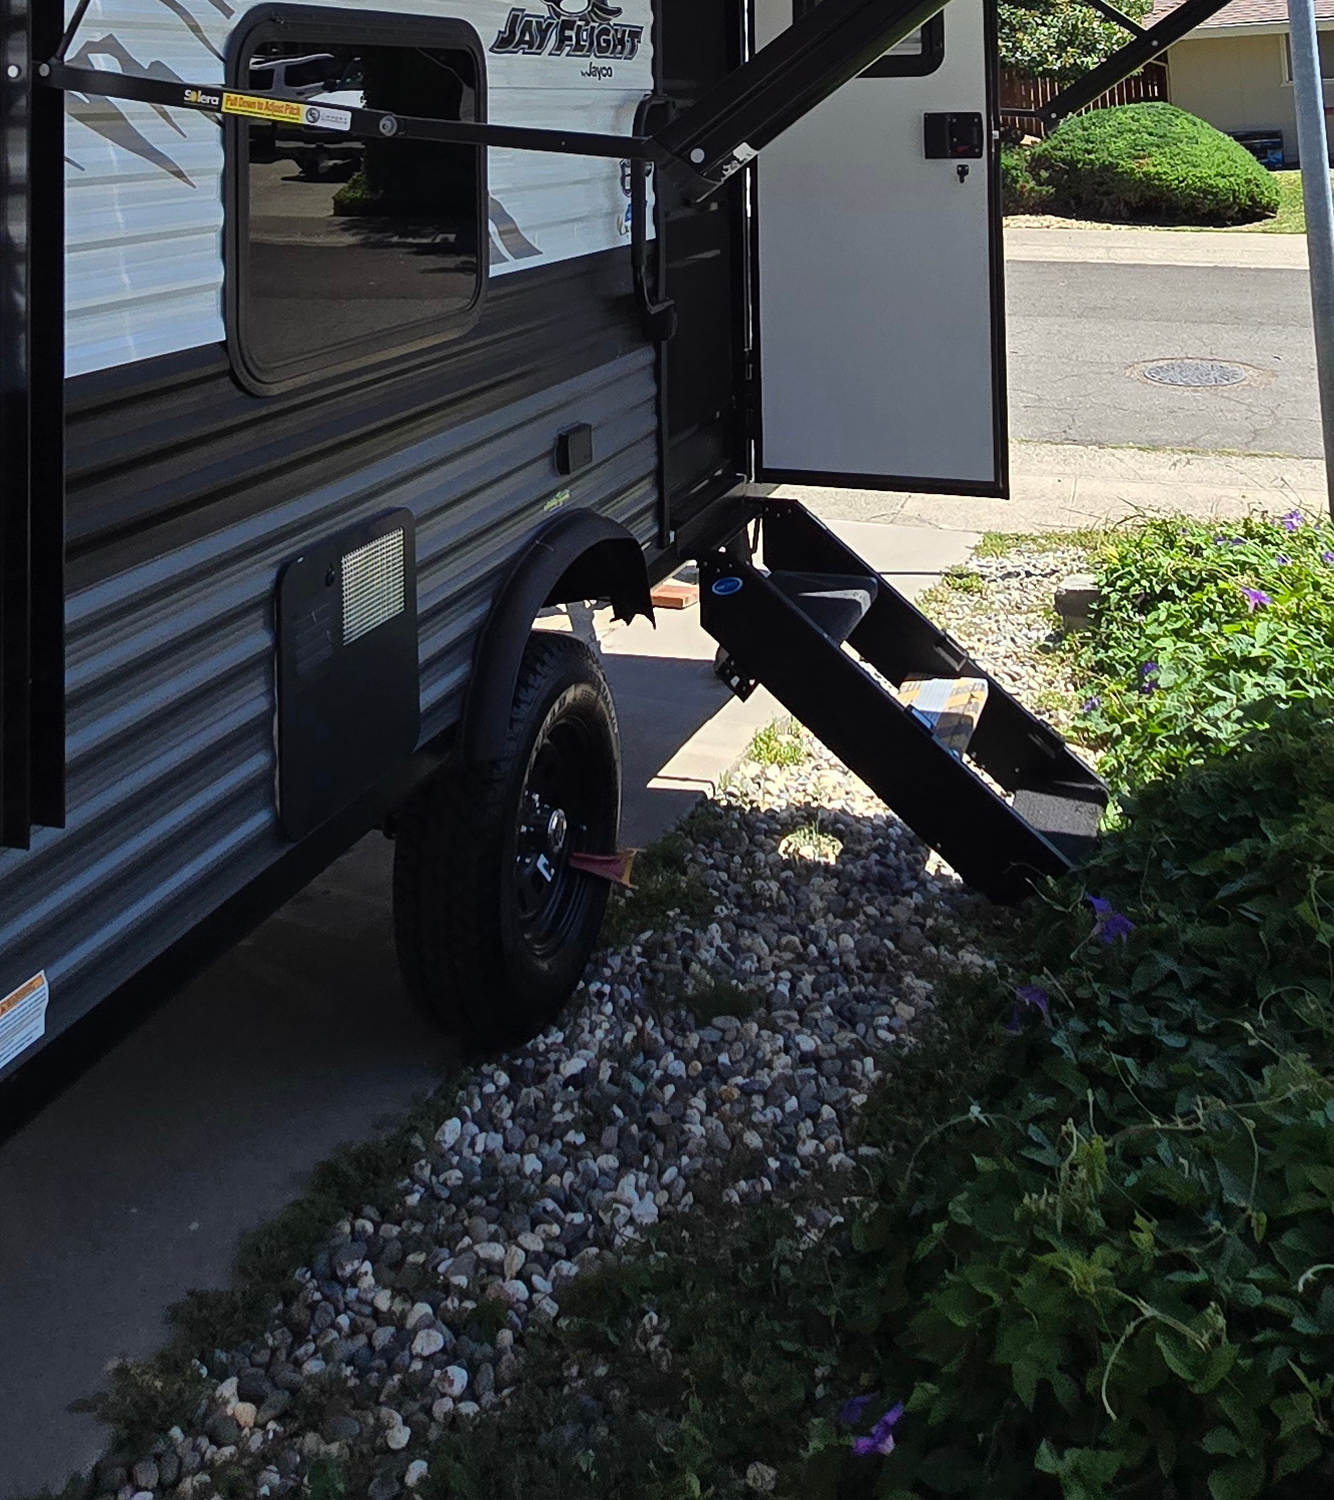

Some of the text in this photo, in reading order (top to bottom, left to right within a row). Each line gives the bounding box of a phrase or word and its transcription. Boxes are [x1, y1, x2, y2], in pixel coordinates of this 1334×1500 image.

[489, 7, 644, 60] JAY FLIGHT
[586, 61, 613, 81] Jayco
[183, 89, 220, 105] Solera
